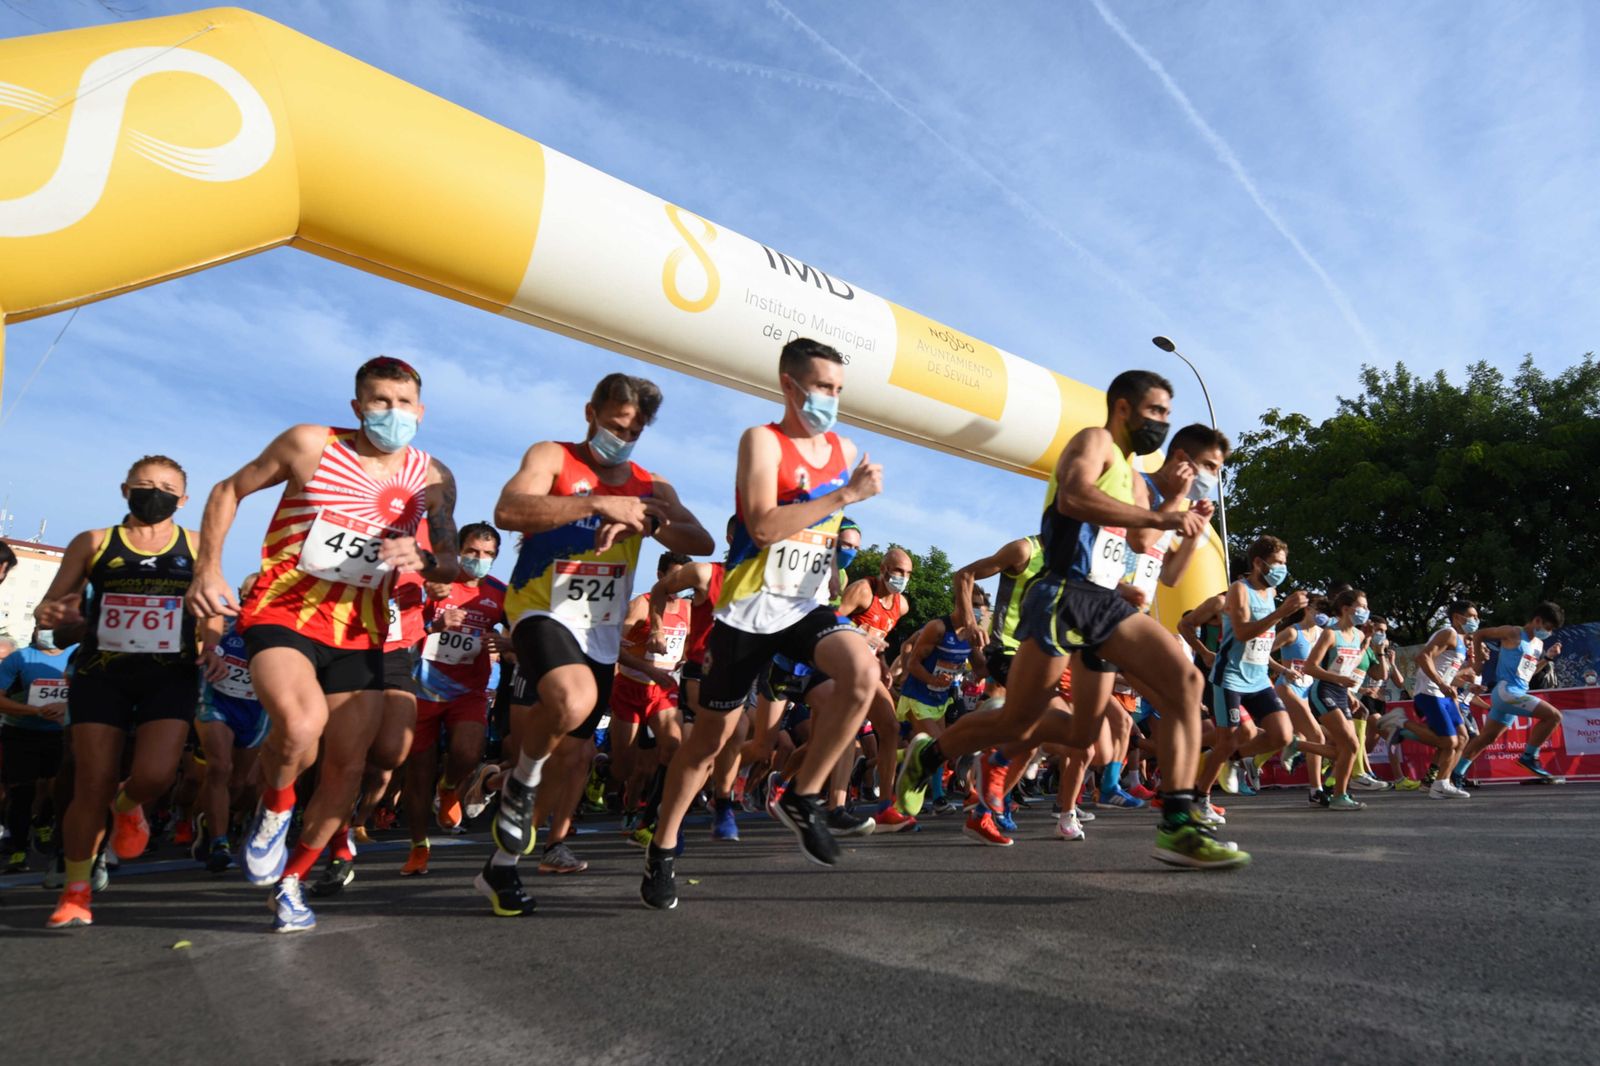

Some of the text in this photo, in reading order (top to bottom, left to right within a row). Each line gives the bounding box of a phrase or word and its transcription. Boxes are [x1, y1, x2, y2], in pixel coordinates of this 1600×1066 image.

[761, 245, 854, 300] IMD
[745, 288, 806, 325] Instituto
[811, 314, 876, 352] Municipal
[763, 323, 783, 341] de
[917, 339, 993, 378] AYUNTAMIENTO
[927, 360, 980, 390] DE SEVILLA
[324, 531, 383, 563] 453
[775, 546, 832, 575] 10165
[567, 578, 616, 602] 524
[104, 608, 175, 631] 8761
[438, 631, 475, 652] 906
